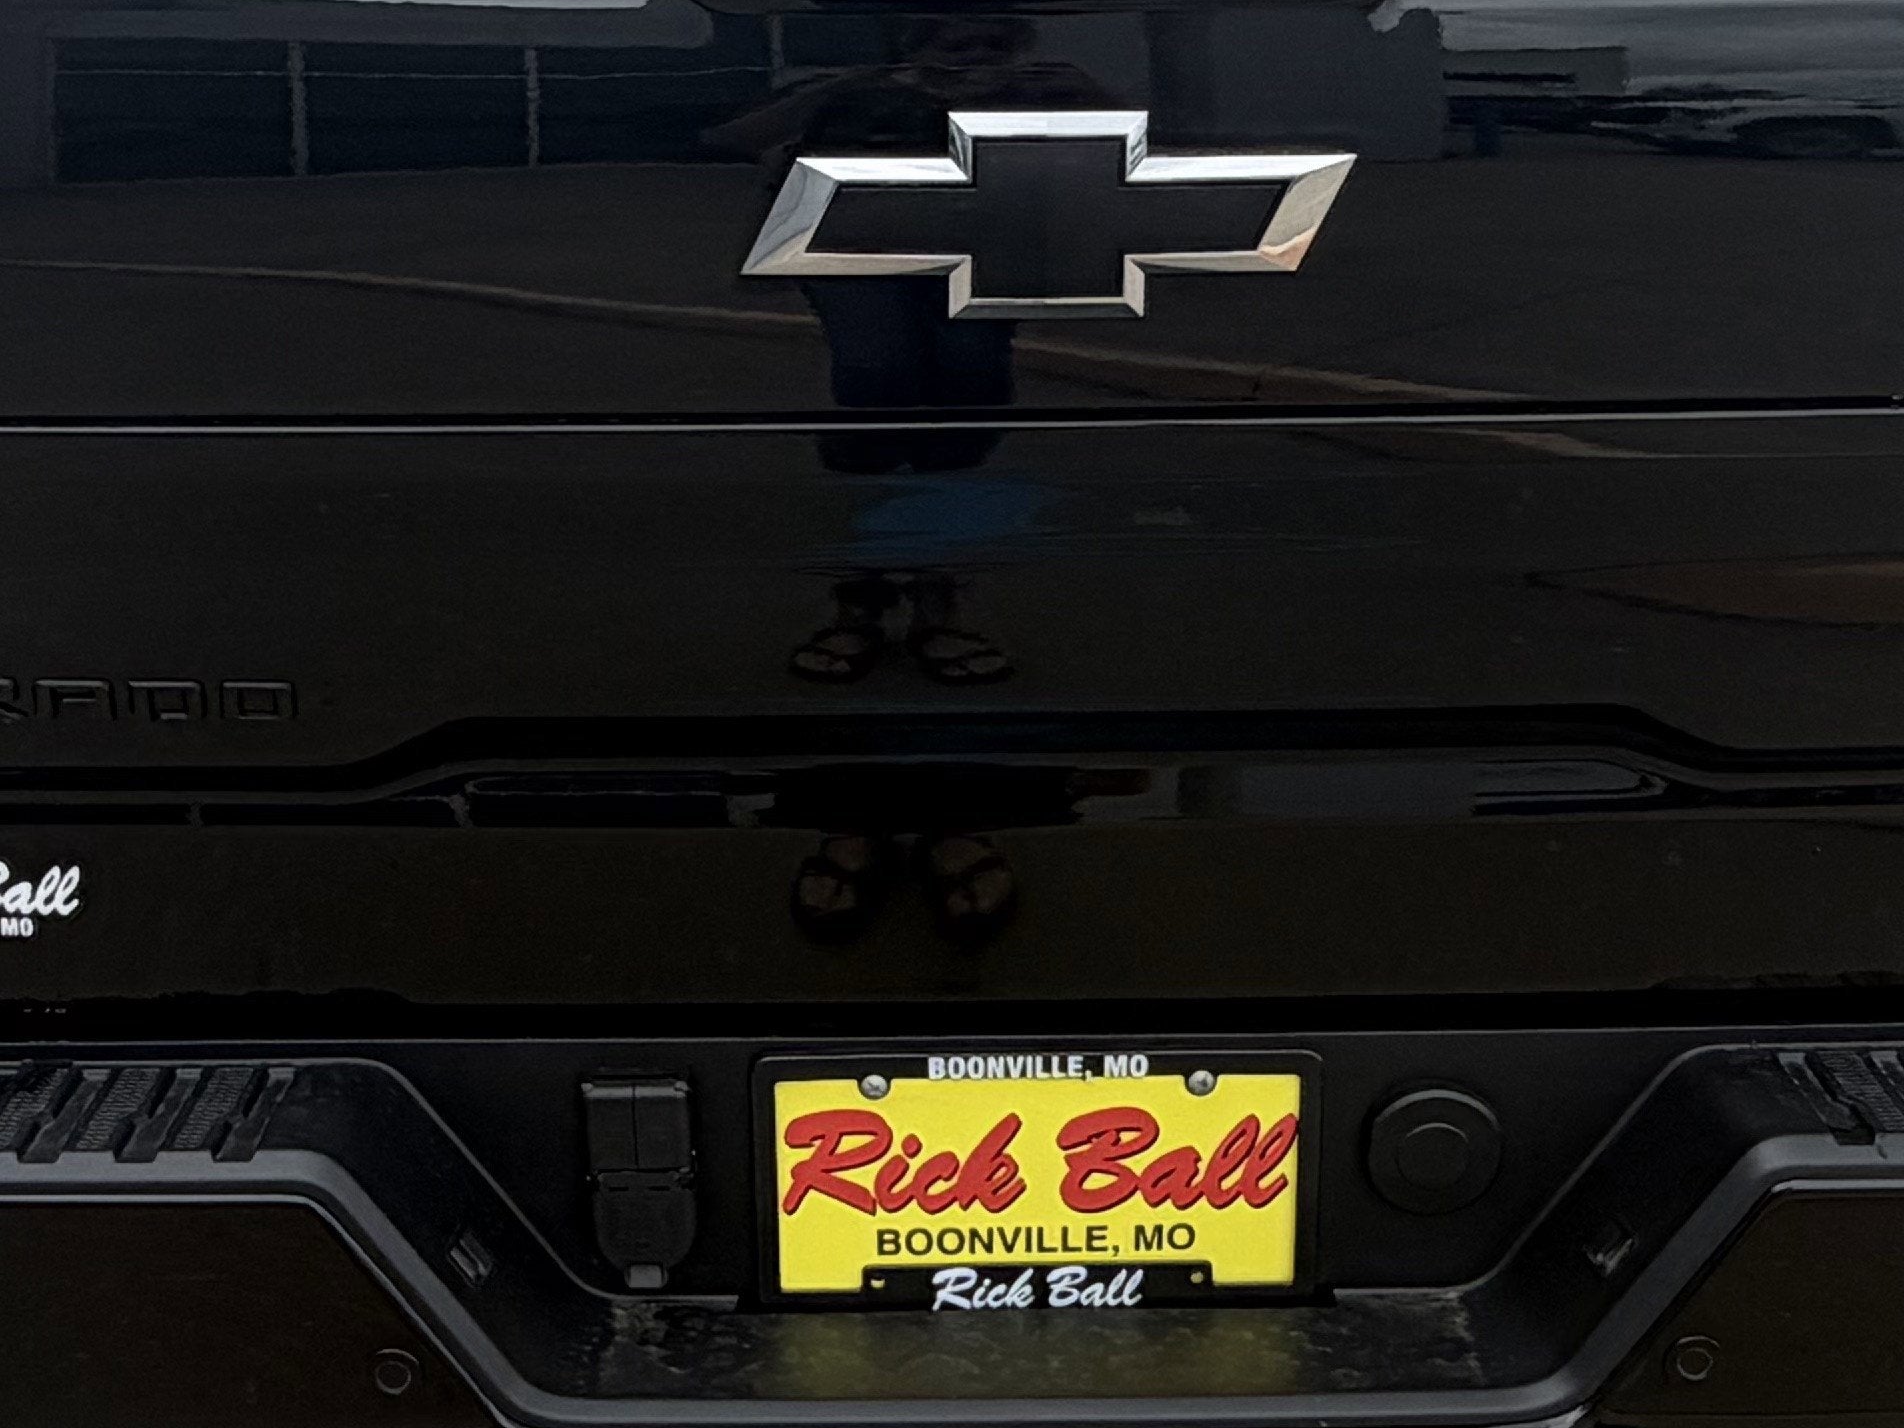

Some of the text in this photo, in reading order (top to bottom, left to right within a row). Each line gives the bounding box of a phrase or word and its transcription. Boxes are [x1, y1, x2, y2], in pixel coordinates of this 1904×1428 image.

[0, 917, 34, 937] MO
[927, 1053, 1150, 1082] BOONVILLE, MO
[782, 1105, 1300, 1217] Rick Ball
[876, 1222, 1197, 1258] BOONVILLE, MO
[930, 1265, 1143, 1312] Rick Ball
